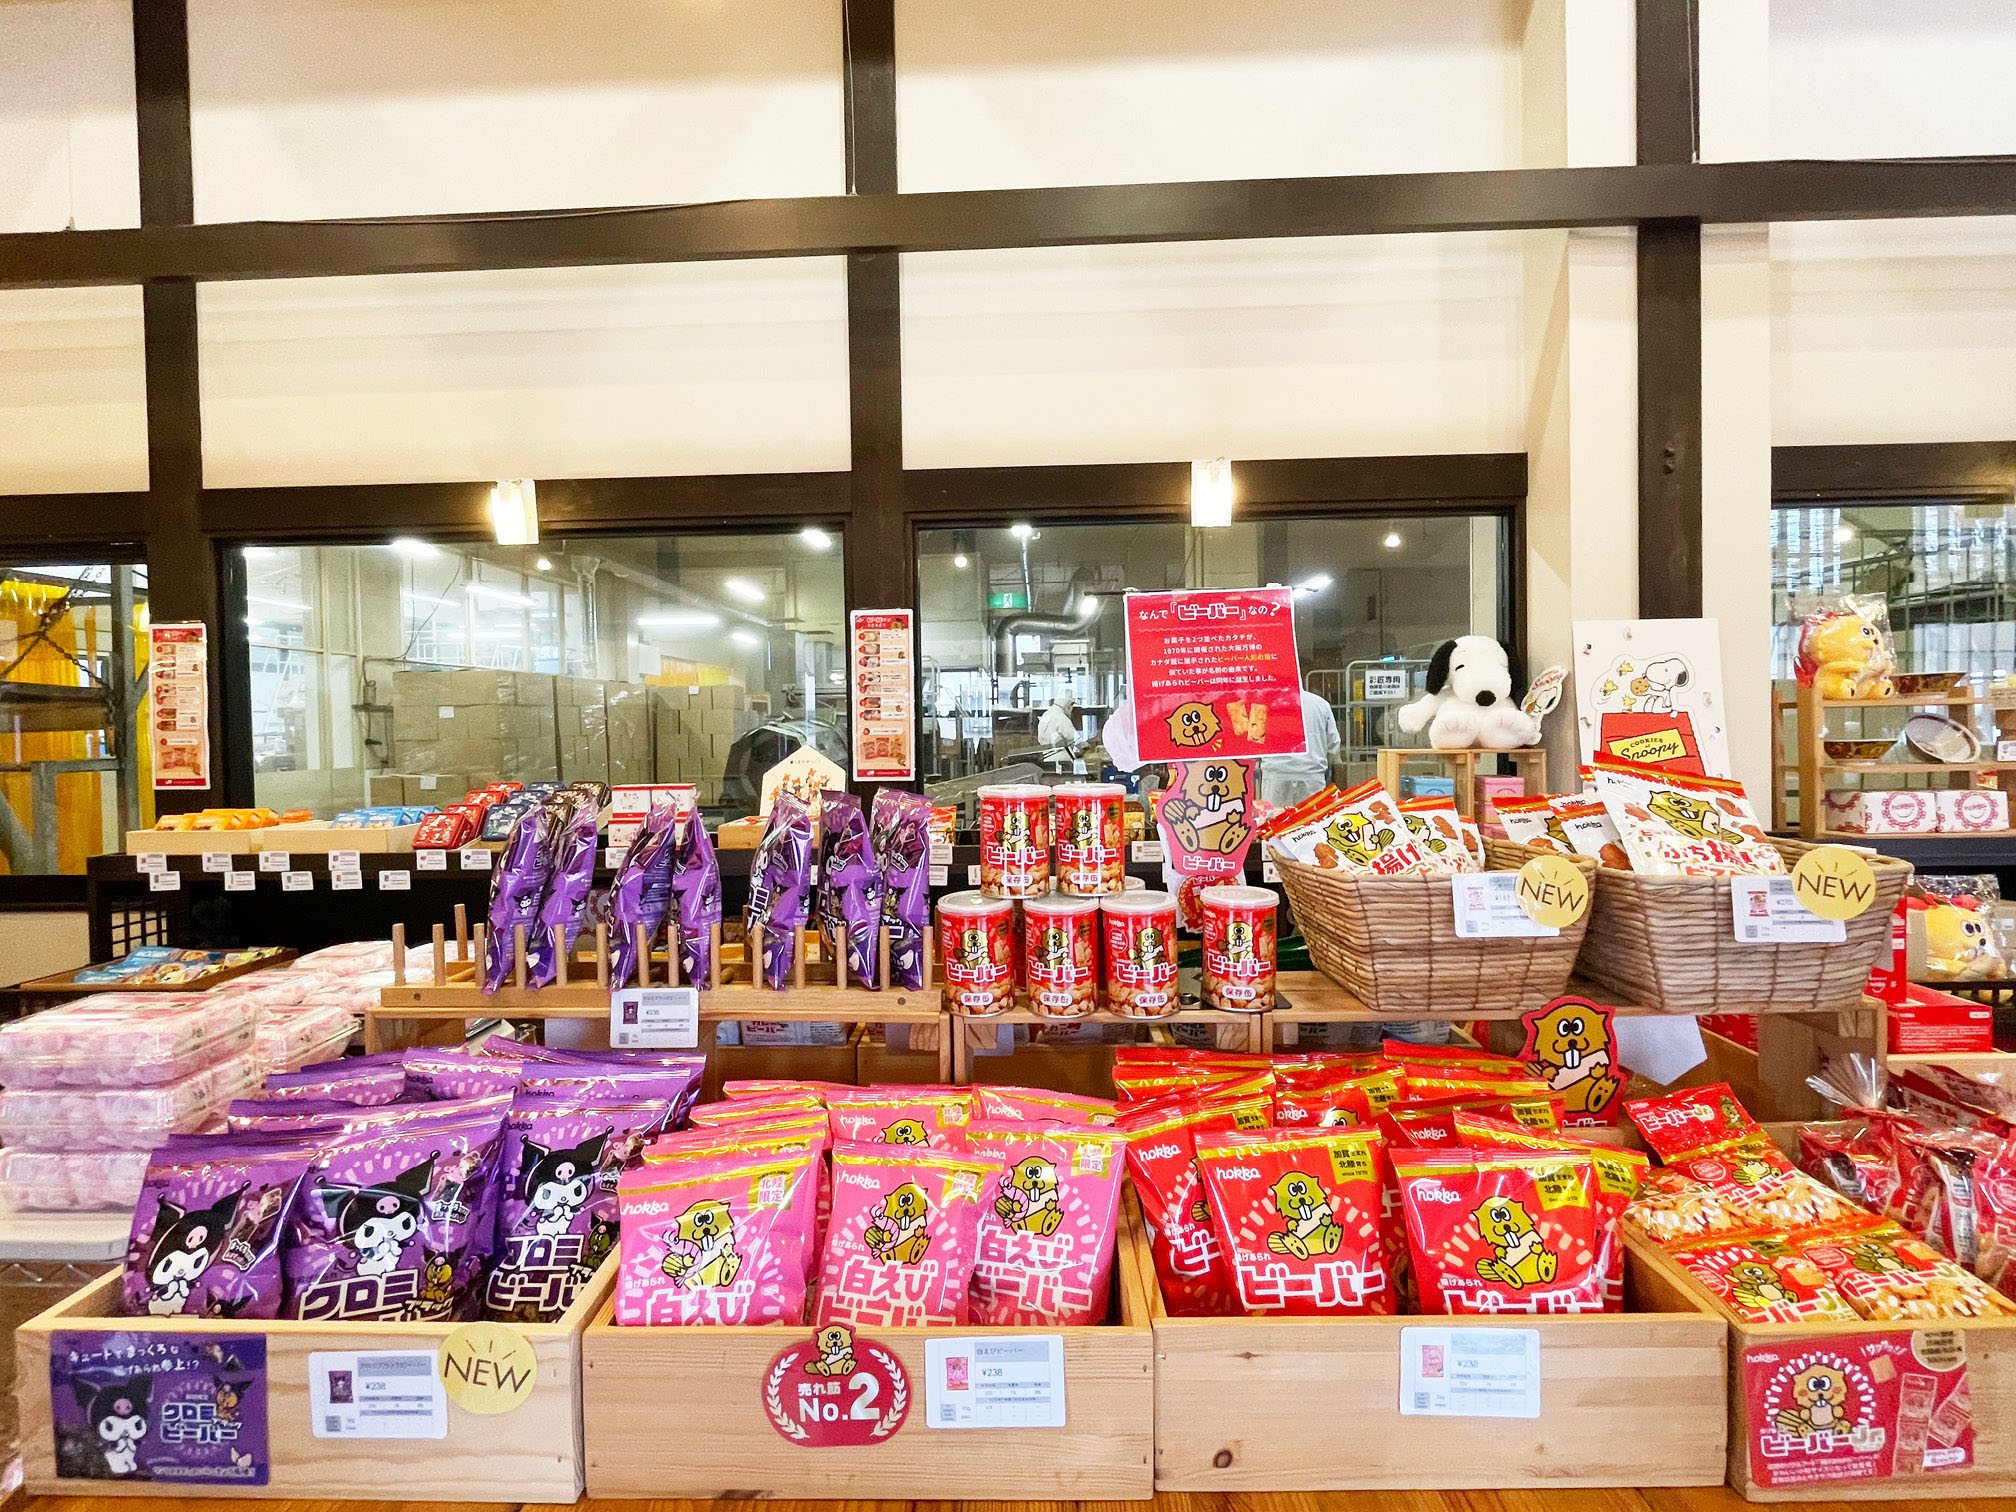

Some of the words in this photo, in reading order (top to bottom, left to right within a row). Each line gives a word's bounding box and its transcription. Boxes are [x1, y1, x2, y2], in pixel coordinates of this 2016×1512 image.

[1620, 742, 1680, 762] Snoopy
[1630, 737, 1663, 748] COOKIES
[986, 845, 1046, 865] ビーバー
[1057, 844, 1117, 864] ビーバー
[1182, 855, 1236, 871] ビーバー
[1520, 876, 1584, 912] NEW
[1797, 872, 1872, 904] NEW
[946, 961, 1008, 982] ビーバー
[1028, 960, 1089, 983] ビーバー
[1116, 962, 1178, 983] ビーバー
[1208, 952, 1271, 977] ビーバー
[1411, 1128, 1448, 1141] hokka
[1138, 1143, 1182, 1163] hokka
[760, 1175, 785, 1189] 北陸
[841, 1170, 881, 1190] hokka
[1216, 1166, 1262, 1182] hokka
[758, 1189, 784, 1205] 限定
[1416, 1187, 1462, 1204] hokka
[621, 1200, 670, 1216] hokka
[839, 1254, 940, 1302] 白えび
[1235, 1260, 1386, 1310] ビーバー
[299, 1268, 419, 1321] クロミ
[646, 1280, 756, 1327] 白えび
[1457, 1359, 1479, 1368] ¥238
[1746, 1353, 1780, 1364] hokka
[443, 1352, 532, 1394] NEW
[982, 1368, 1003, 1377] ¥238
[797, 1381, 841, 1397] 売れ筋
[161, 1402, 218, 1422] クロミ
[160, 1423, 239, 1444] ビーバー
